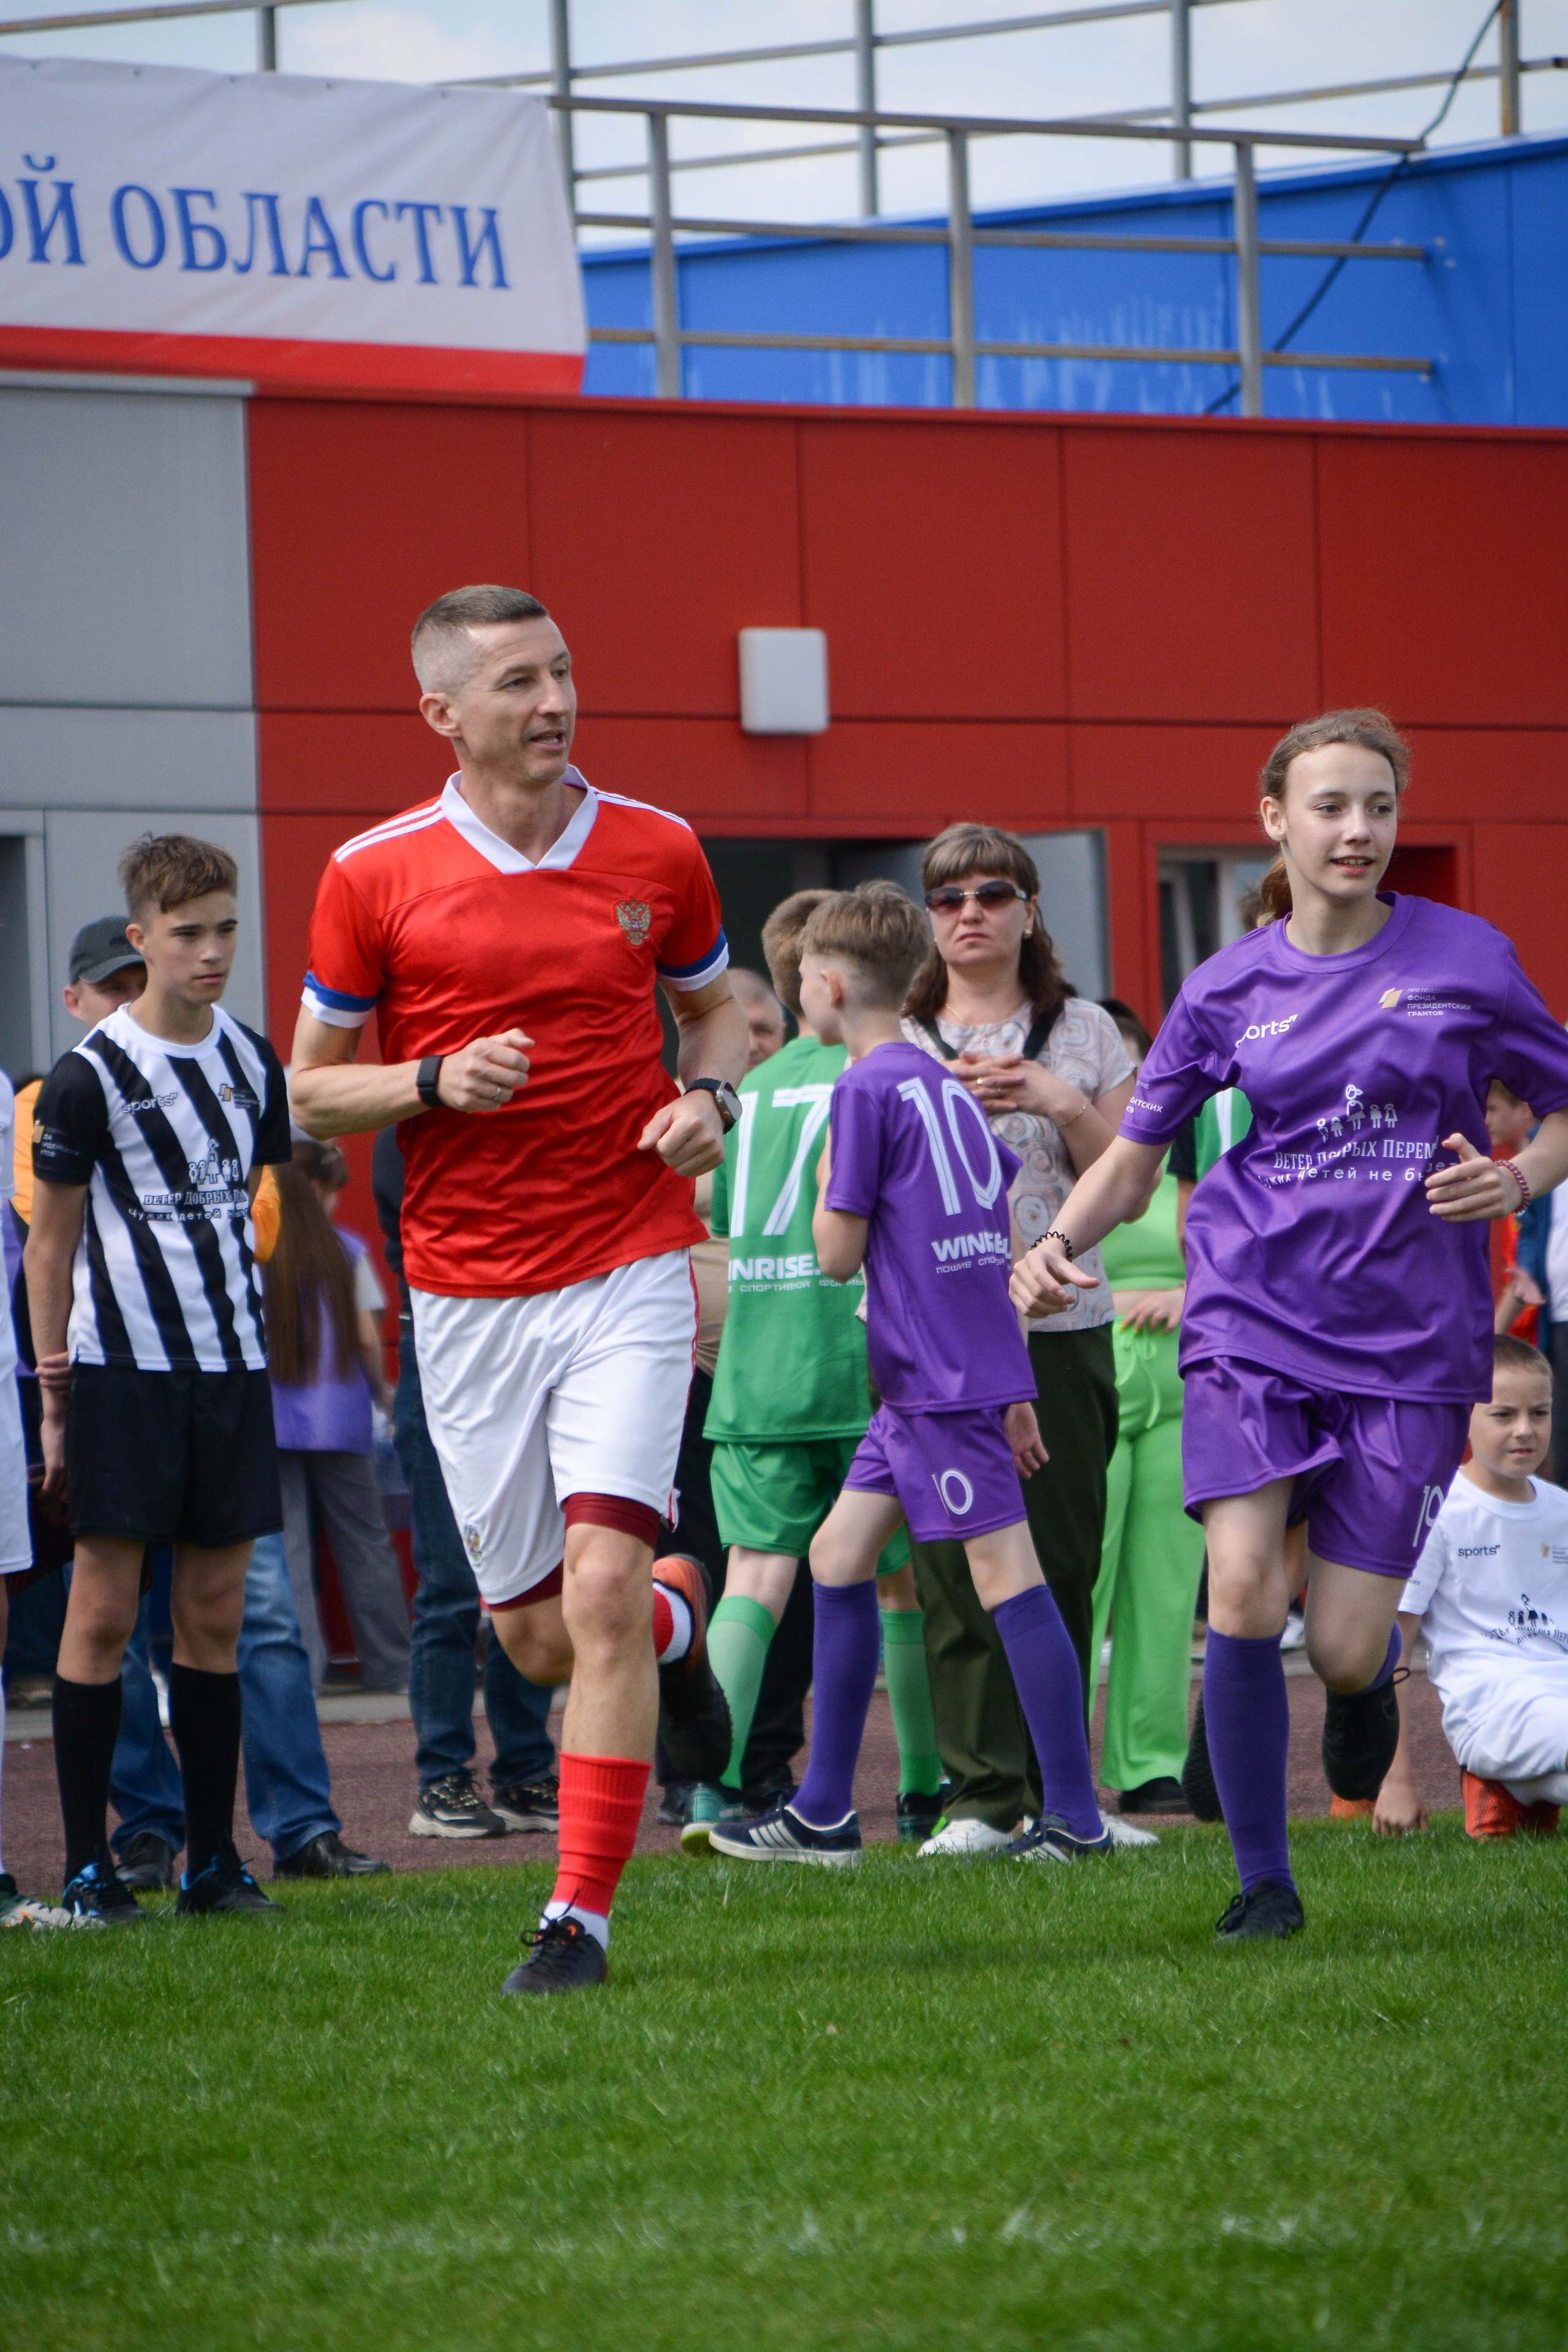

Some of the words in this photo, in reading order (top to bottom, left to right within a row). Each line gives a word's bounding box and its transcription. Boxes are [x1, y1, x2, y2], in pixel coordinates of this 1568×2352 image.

[0, 153, 85, 265] Й
[110, 184, 510, 288] ОБЛАСТИ
[897, 1077, 1001, 1216] 10
[730, 1084, 834, 1238] 17
[1273, 1152, 1313, 1170] ВЕТЕР
[1370, 1170, 1392, 1181] не
[144, 1193, 183, 1205] ВЕТЕР
[184, 1191, 232, 1205] ДОБРЫХ
[178, 1208, 221, 1221] детей
[936, 1261, 971, 1274] ПОШИВ
[740, 1281, 810, 1293] СПОРТИВНОЙ
